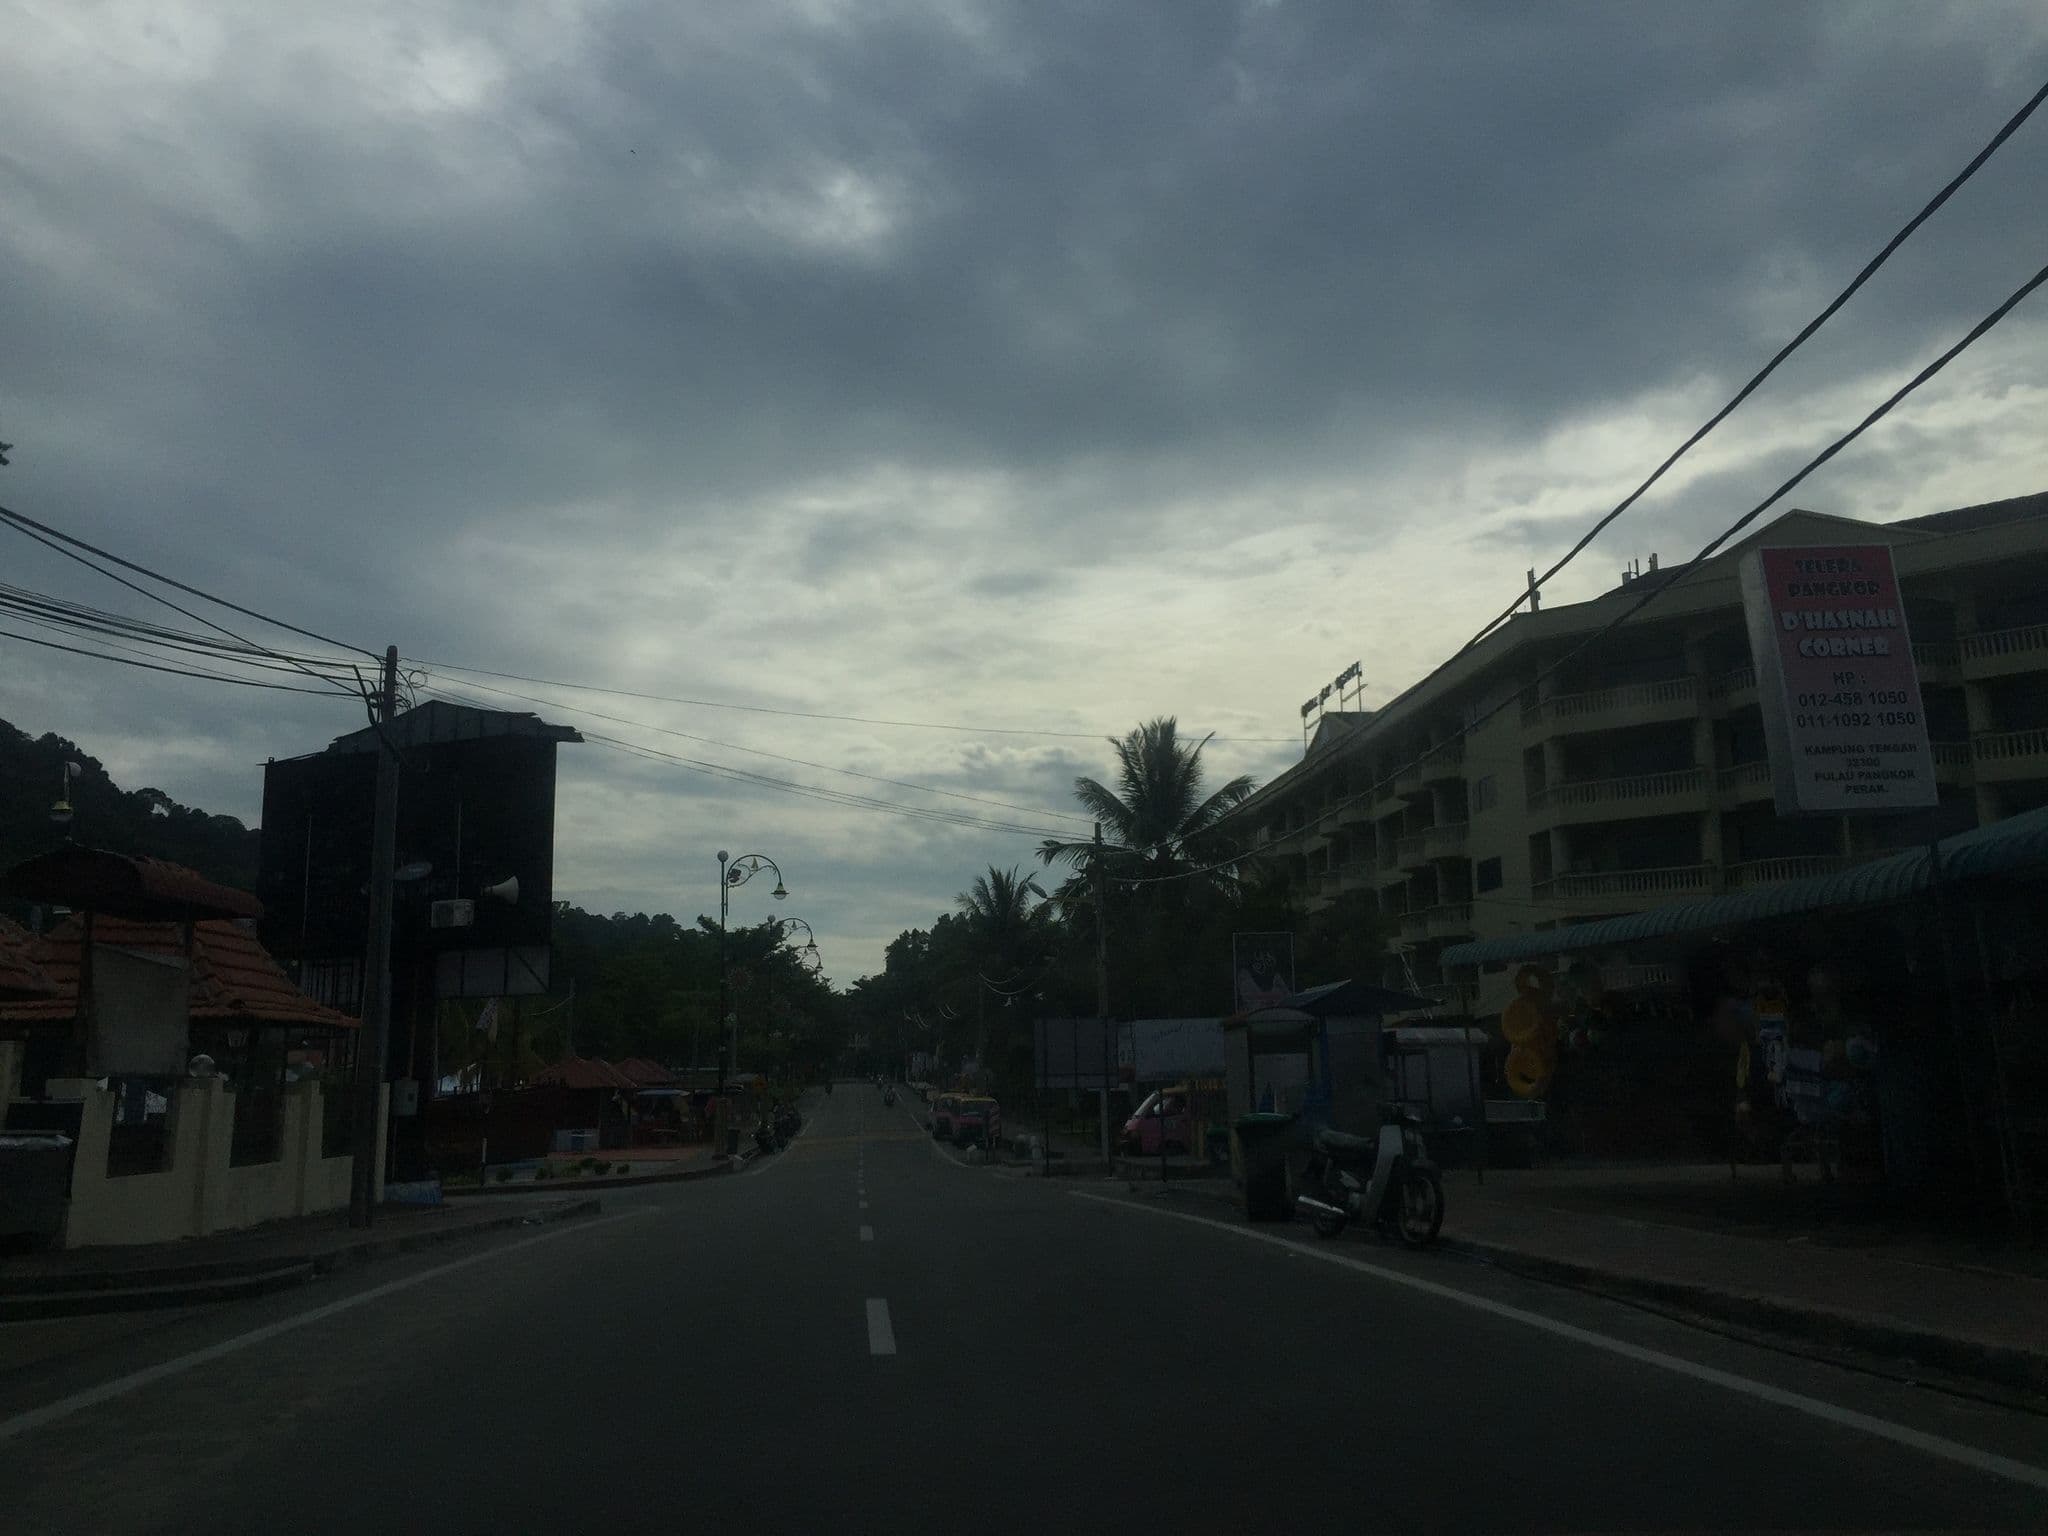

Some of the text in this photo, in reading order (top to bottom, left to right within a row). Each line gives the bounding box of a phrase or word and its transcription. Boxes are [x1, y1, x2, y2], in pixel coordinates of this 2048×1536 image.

[1798, 638, 1890, 658] CORNER
[1798, 690, 1908, 707] 012-458 1050
[1876, 711, 1917, 727] 1050
[1804, 743, 1917, 755] KAMPUNG TENGAH
[1814, 769, 1916, 782] PULAU PANGKOR
